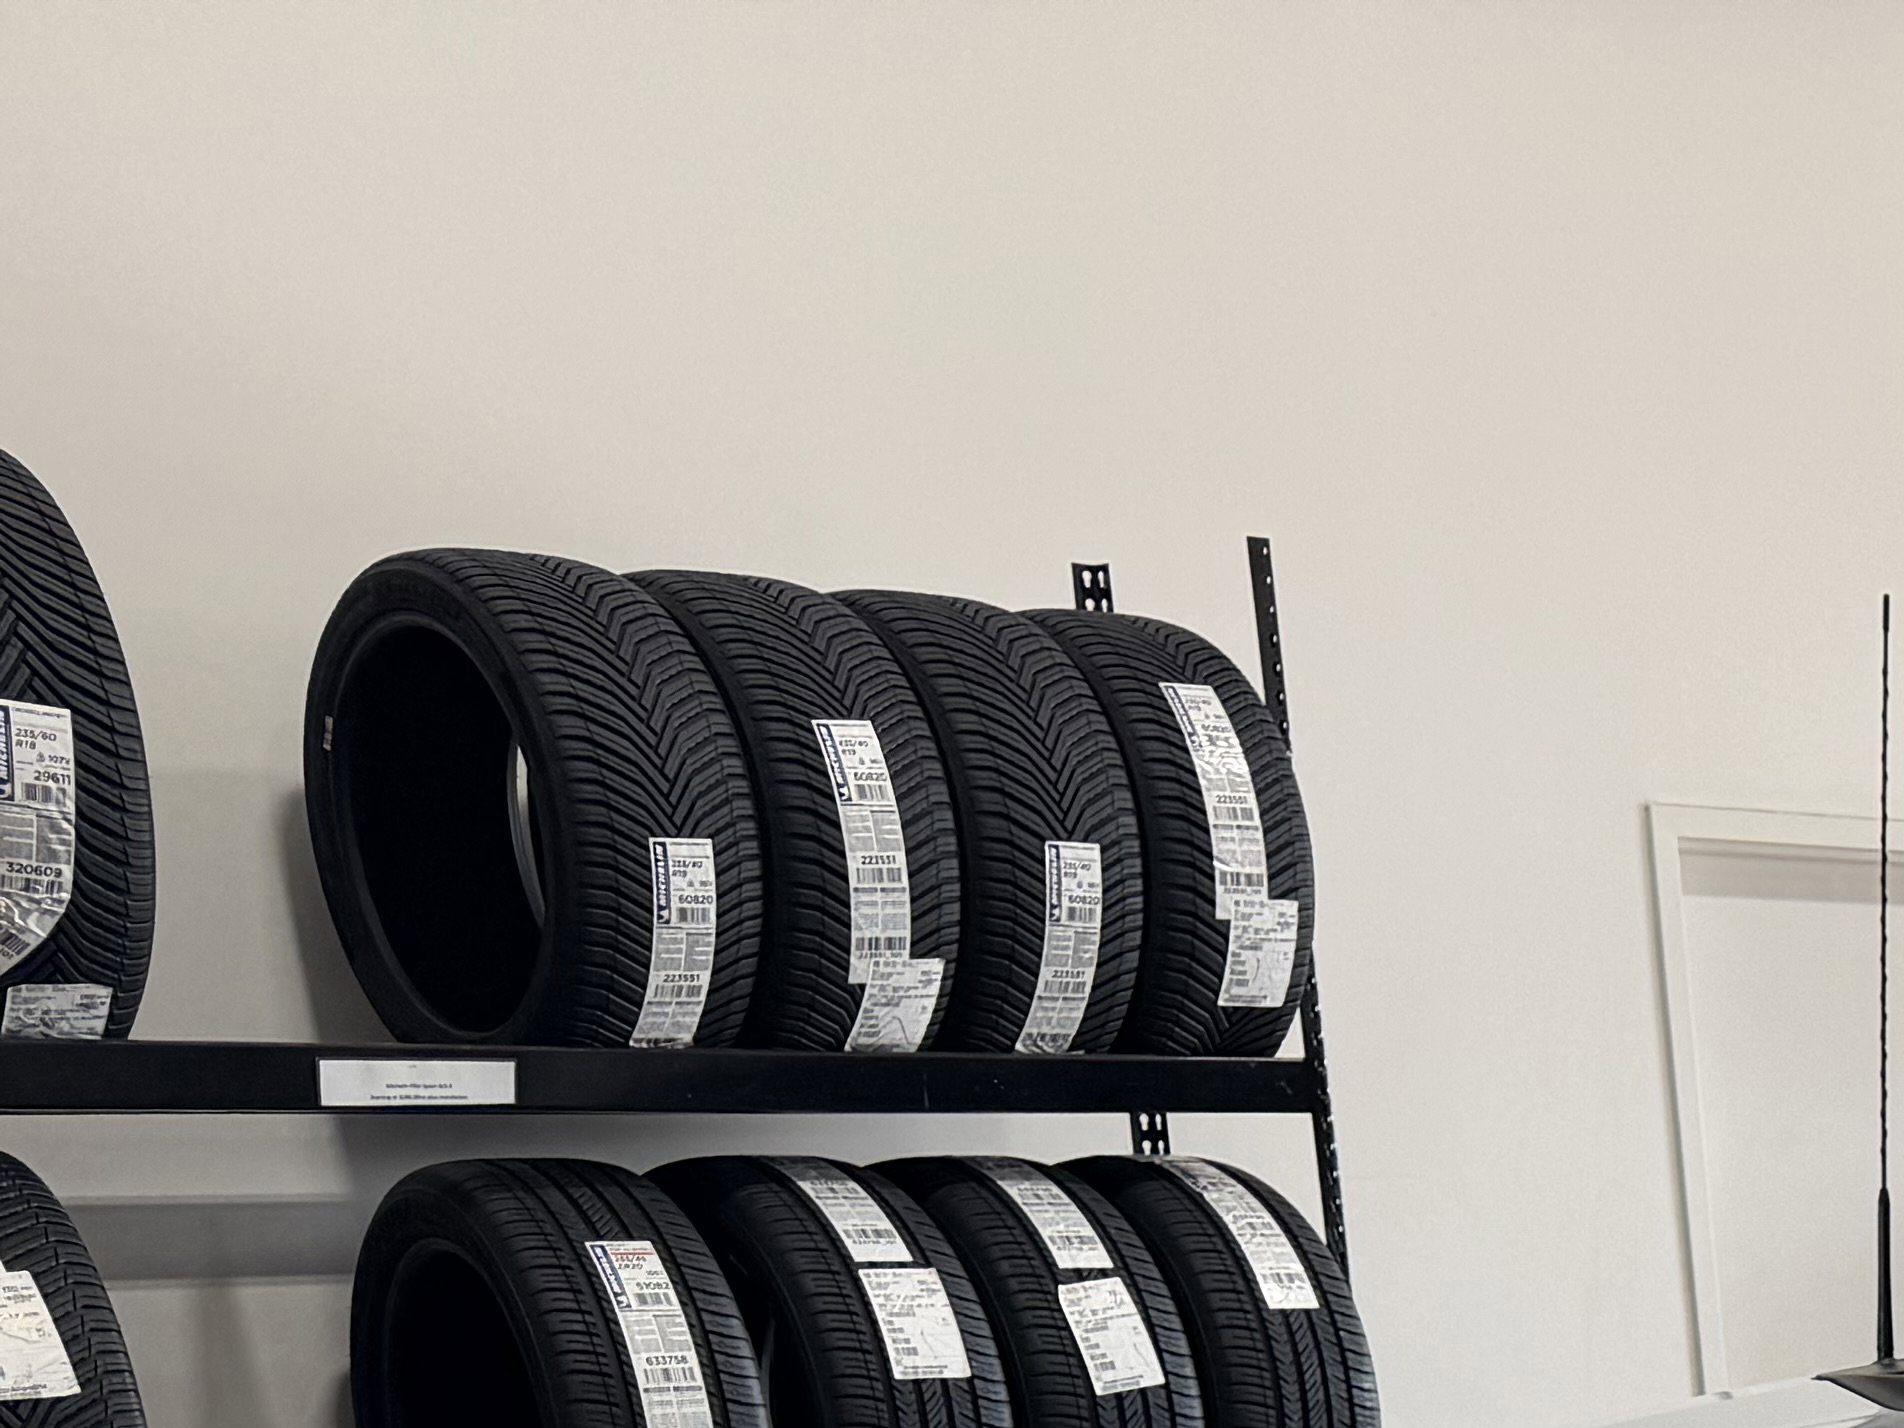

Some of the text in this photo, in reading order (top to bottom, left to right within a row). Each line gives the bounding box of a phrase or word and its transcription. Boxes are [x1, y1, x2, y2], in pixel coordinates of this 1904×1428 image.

[15, 728, 57, 742] 235/60
[15, 740, 37, 750] R18
[33, 770, 71, 786] 29611
[6, 861, 63, 879] 320609
[678, 894, 713, 905] 60820
[645, 1356, 689, 1366] 633758
